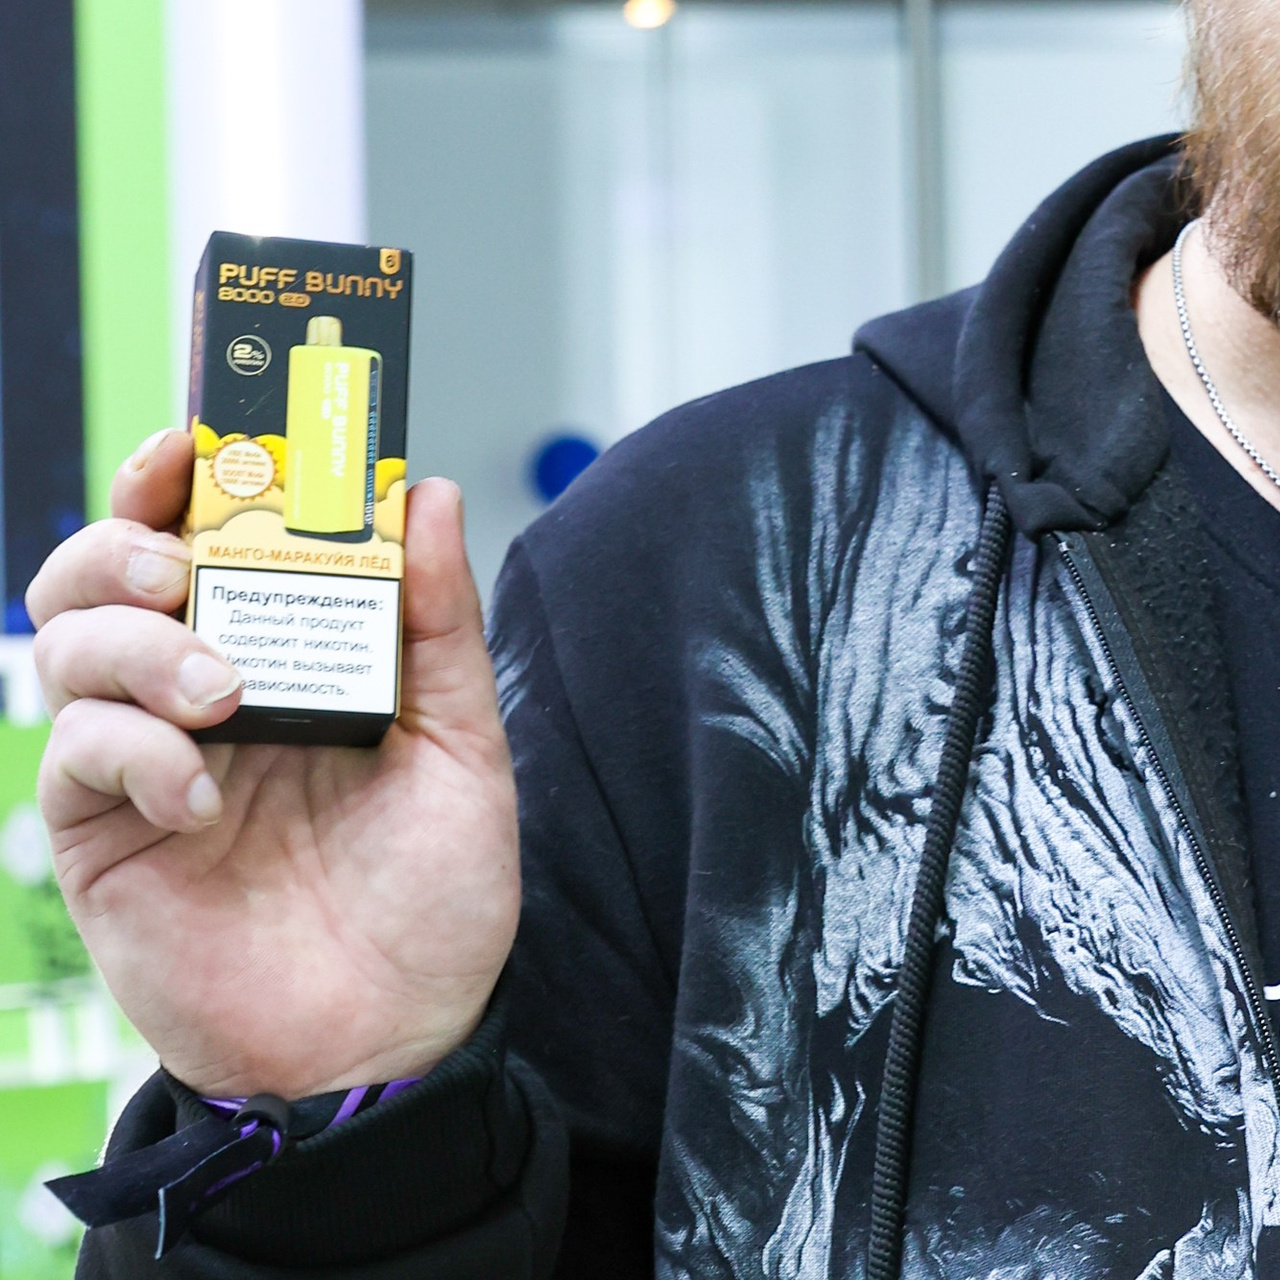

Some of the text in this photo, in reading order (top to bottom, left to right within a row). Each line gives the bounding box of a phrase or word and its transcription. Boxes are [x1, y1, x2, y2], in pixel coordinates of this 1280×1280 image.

[218, 263, 403, 299] PUFF BUNNY
[208, 546, 391, 571] МАНГО-МАРАКУЙЯ ЛЁД
[212, 586, 384, 611] Предупреждение:
[229, 610, 365, 633] Данный продукт
[218, 633, 374, 654] содержит никотин.
[293, 660, 373, 675] вызывает
